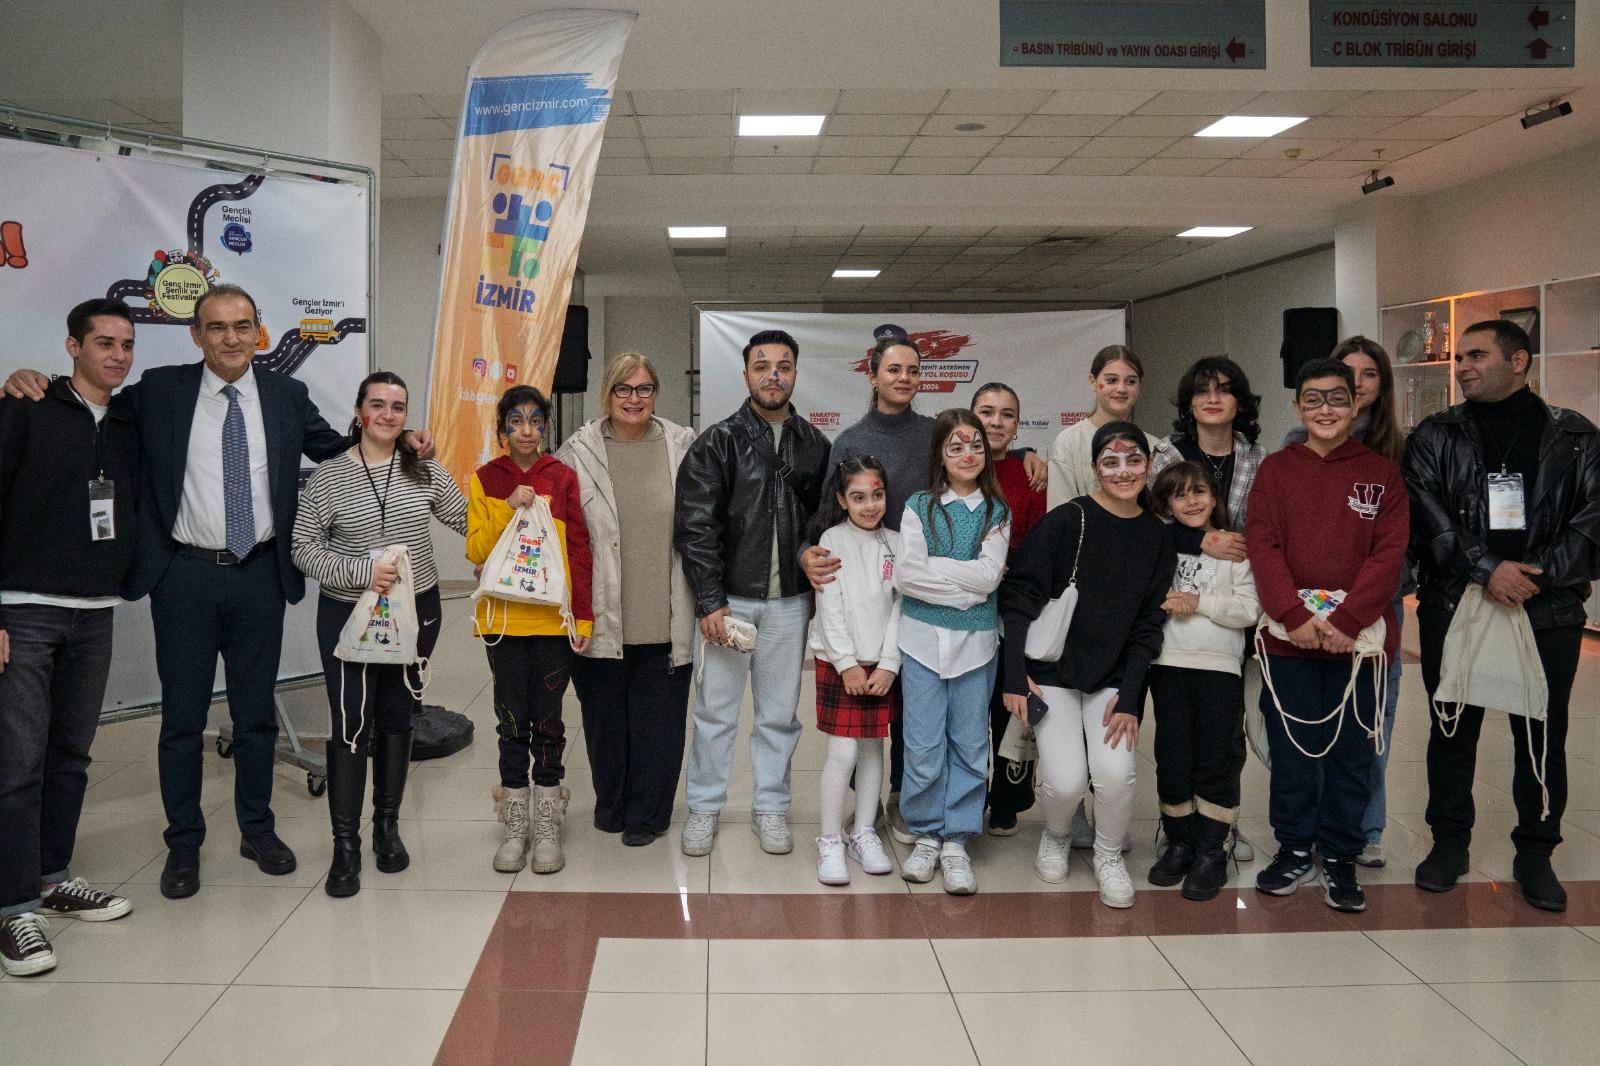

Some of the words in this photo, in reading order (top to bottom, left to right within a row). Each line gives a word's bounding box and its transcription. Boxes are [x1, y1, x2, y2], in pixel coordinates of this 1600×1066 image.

[1333, 9, 1419, 27] KONDÜSİYON
[1423, 12, 1478, 28] SALONU
[1021, 42, 1054, 55] BASIN
[1057, 41, 1103, 56] TRİBÜNÜ
[1106, 46, 1118, 56] ve
[1120, 46, 1151, 57] YAYIN
[1154, 46, 1187, 57] ODASI
[1190, 43, 1221, 60] GİRİŞİ
[1333, 42, 1342, 56] C
[1346, 42, 1383, 57] BLOK
[1385, 39, 1434, 57] TRİBÜN
[1437, 39, 1477, 61] GİRİŞİ
[474, 97, 588, 117] www.gencizmir.com
[221, 205, 253, 216] Gençlik
[222, 214, 251, 224] Meclisi
[162, 280, 182, 289] Genç
[162, 292, 199, 301] Festivalle
[165, 287, 188, 295] Şenlik
[475, 274, 537, 314] İZMİR
[292, 297, 321, 307] Gençler
[322, 299, 345, 308] İzmir'i
[304, 307, 333, 316] Geziyor
[939, 371, 969, 379] KOŞUSU
[513, 563, 537, 576] İZMİR
